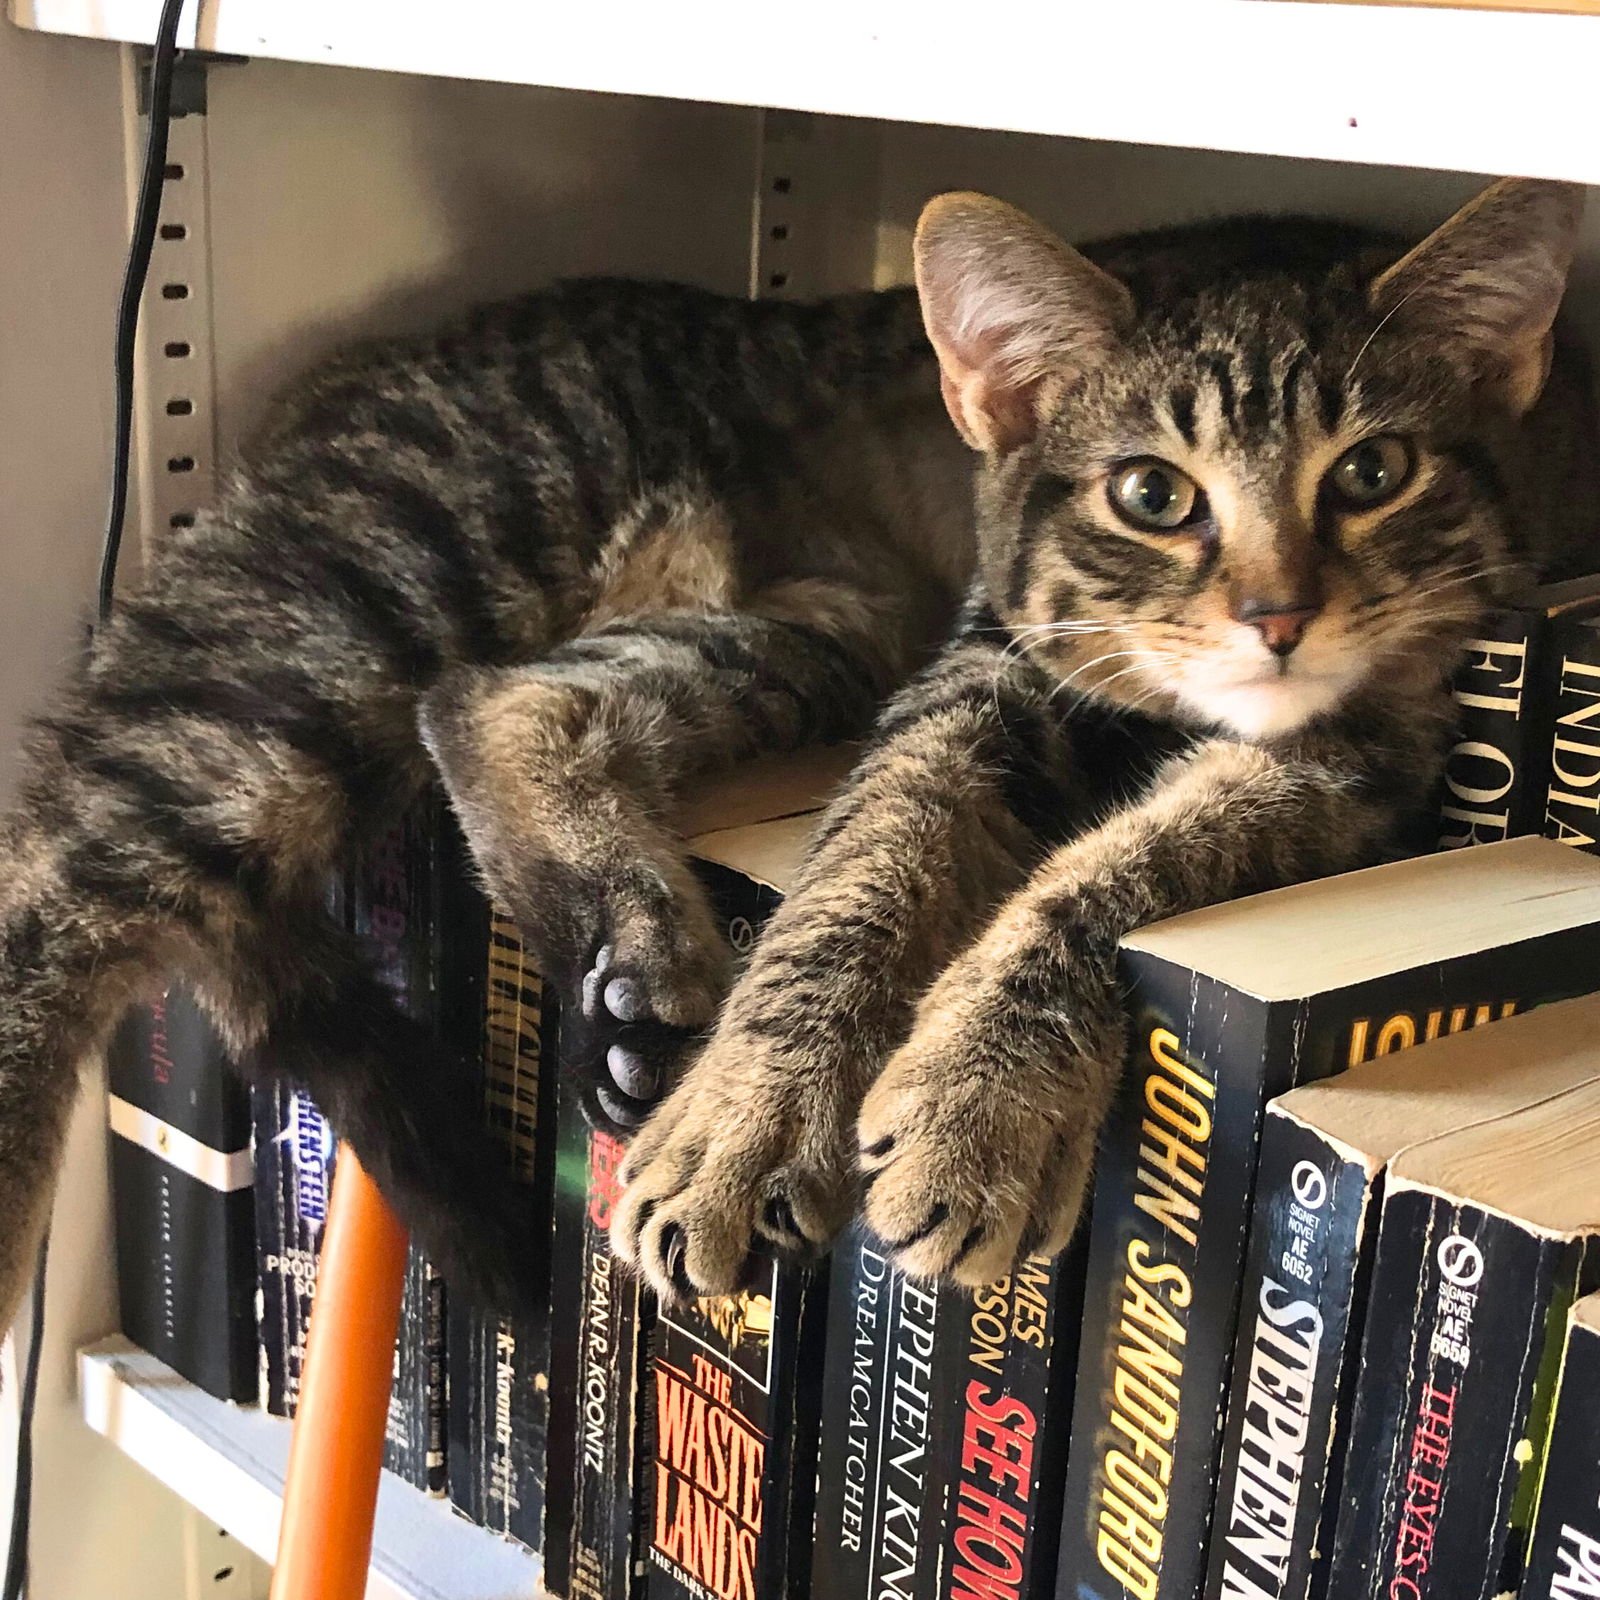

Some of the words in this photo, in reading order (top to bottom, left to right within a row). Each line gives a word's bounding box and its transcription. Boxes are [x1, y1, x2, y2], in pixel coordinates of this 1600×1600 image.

[1133, 1026, 1215, 1247] JOHN
[1288, 1217, 1316, 1243] NOVEL
[1289, 1202, 1320, 1229] SIGNET
[1291, 1236, 1309, 1260] AE
[590, 1251, 611, 1331] DEAN
[1282, 1251, 1313, 1286] 6052
[1437, 1296, 1473, 1323] NOVEL
[1438, 1281, 1478, 1308] SIGNET
[1442, 1315, 1466, 1341] AE
[496, 1361, 515, 1445] Koontz
[584, 1360, 606, 1474] KOONTZ
[691, 1353, 733, 1409] THE
[840, 1246, 886, 1551] DREAMCATCHER
[888, 1274, 939, 1490] EPHEN
[1096, 1238, 1192, 1600] SANDFORD
[655, 1367, 765, 1535] WASTE
[961, 1378, 1037, 1502] SEE
[1225, 1275, 1324, 1586] STEPHEN
[1411, 1382, 1457, 1470] THE
[654, 1460, 757, 1600] LANDS
[877, 1484, 921, 1600] KIN
[1394, 1467, 1441, 1575] EYES
[648, 1545, 672, 1574] THE
[672, 1564, 705, 1600] DARK
